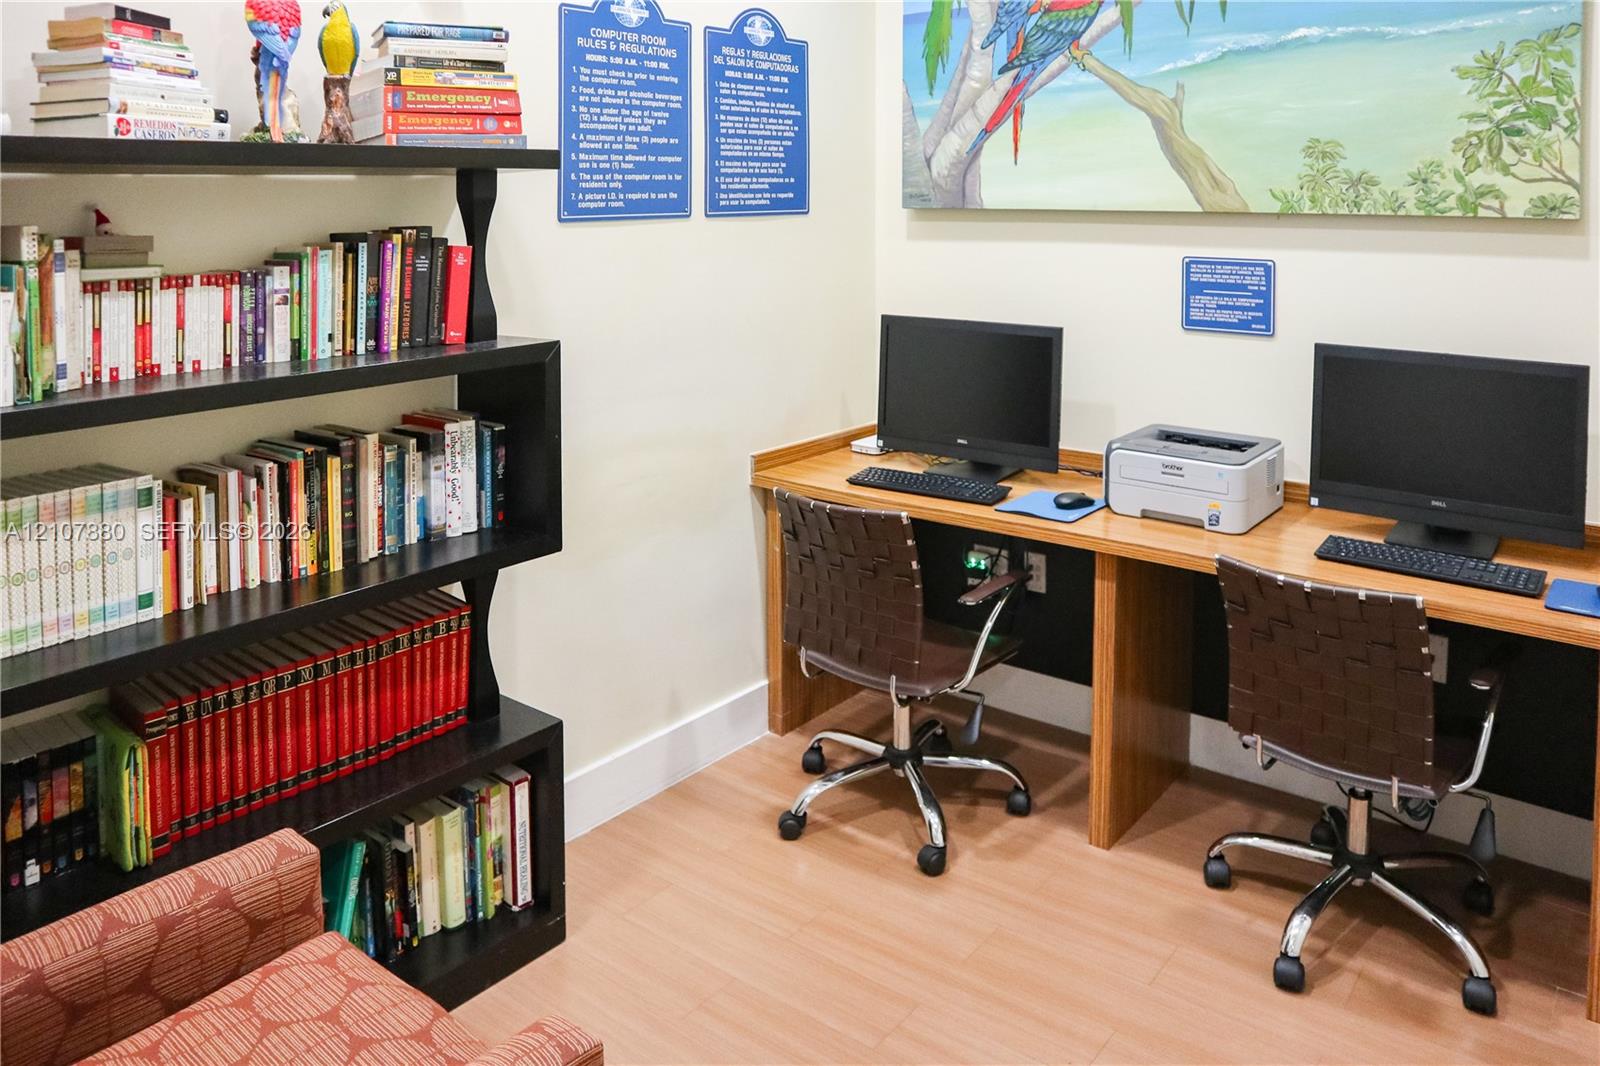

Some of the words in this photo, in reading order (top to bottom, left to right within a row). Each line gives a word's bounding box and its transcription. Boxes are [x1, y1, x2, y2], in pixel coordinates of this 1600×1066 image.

[397, 25, 430, 37] PREPARED
[590, 27, 638, 42] COMPUTER
[641, 34, 666, 46] ROOM
[577, 37, 606, 49] RULES
[610, 41, 615, 50] &
[619, 42, 676, 57] REGULATIONS
[722, 46, 744, 56] REGLAS
[751, 50, 791, 62] REGULACIONES
[713, 55, 724, 64] DEL
[726, 56, 744, 66] SALON
[746, 59, 753, 67] DE
[755, 60, 798, 73] COMPUTADORAS
[591, 76, 618, 84] computer
[634, 72, 646, 80] prior
[656, 74, 677, 83] entering
[406, 90, 492, 105] Emergency
[655, 93, 682, 101] beverages
[134, 118, 176, 129] REMEDIOS
[398, 115, 473, 126] Emergency
[579, 122, 617, 130] accompanied
[134, 128, 176, 139] CASEROS
[402, 302, 411, 339] LAZYBONES
[450, 430, 459, 474] Unbearably
[450, 478, 460, 502] Good!
[440, 622, 446, 634] B
[369, 649, 376, 661] H
[322, 665, 332, 676] M
[339, 657, 352, 671] KL
[301, 667, 314, 681] NO
[263, 679, 276, 695] QR
[284, 675, 291, 688] P
[200, 700, 214, 716] UV
[218, 694, 227, 710] T
